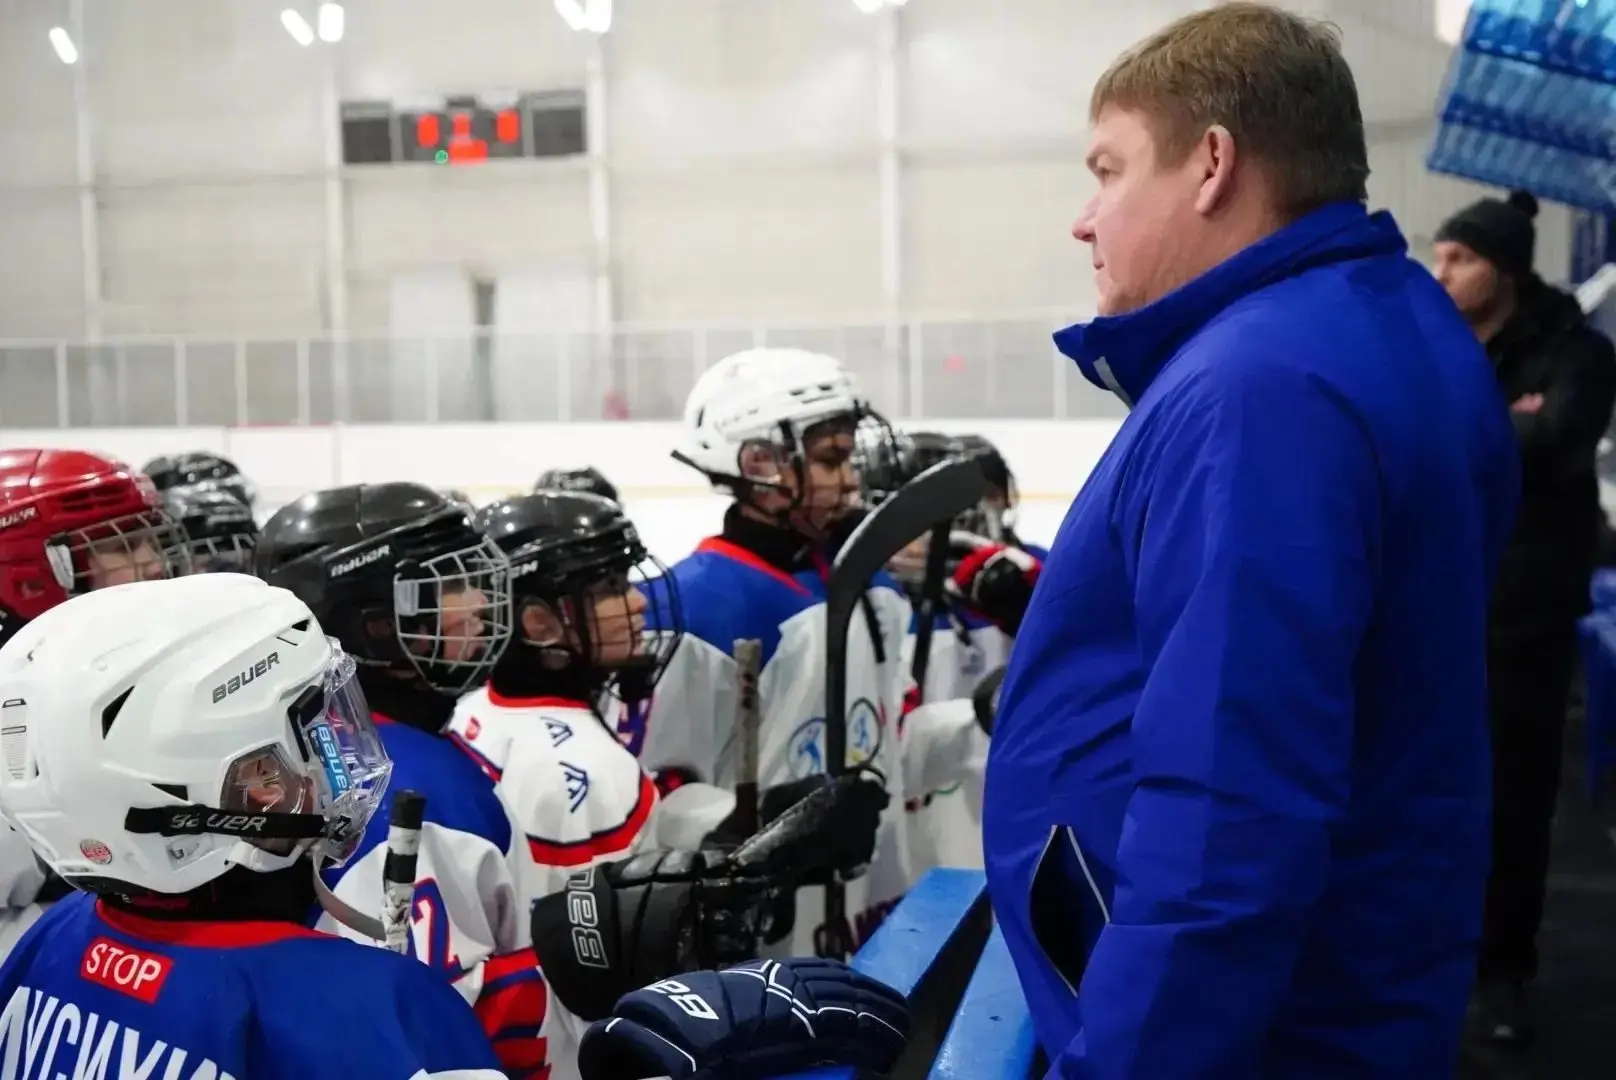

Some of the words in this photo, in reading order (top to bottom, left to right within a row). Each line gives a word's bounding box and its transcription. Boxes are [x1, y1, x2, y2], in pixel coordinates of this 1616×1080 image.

[212, 651, 280, 704] BAUER
[318, 726, 350, 797] BAUE
[86, 943, 162, 991] STOP
